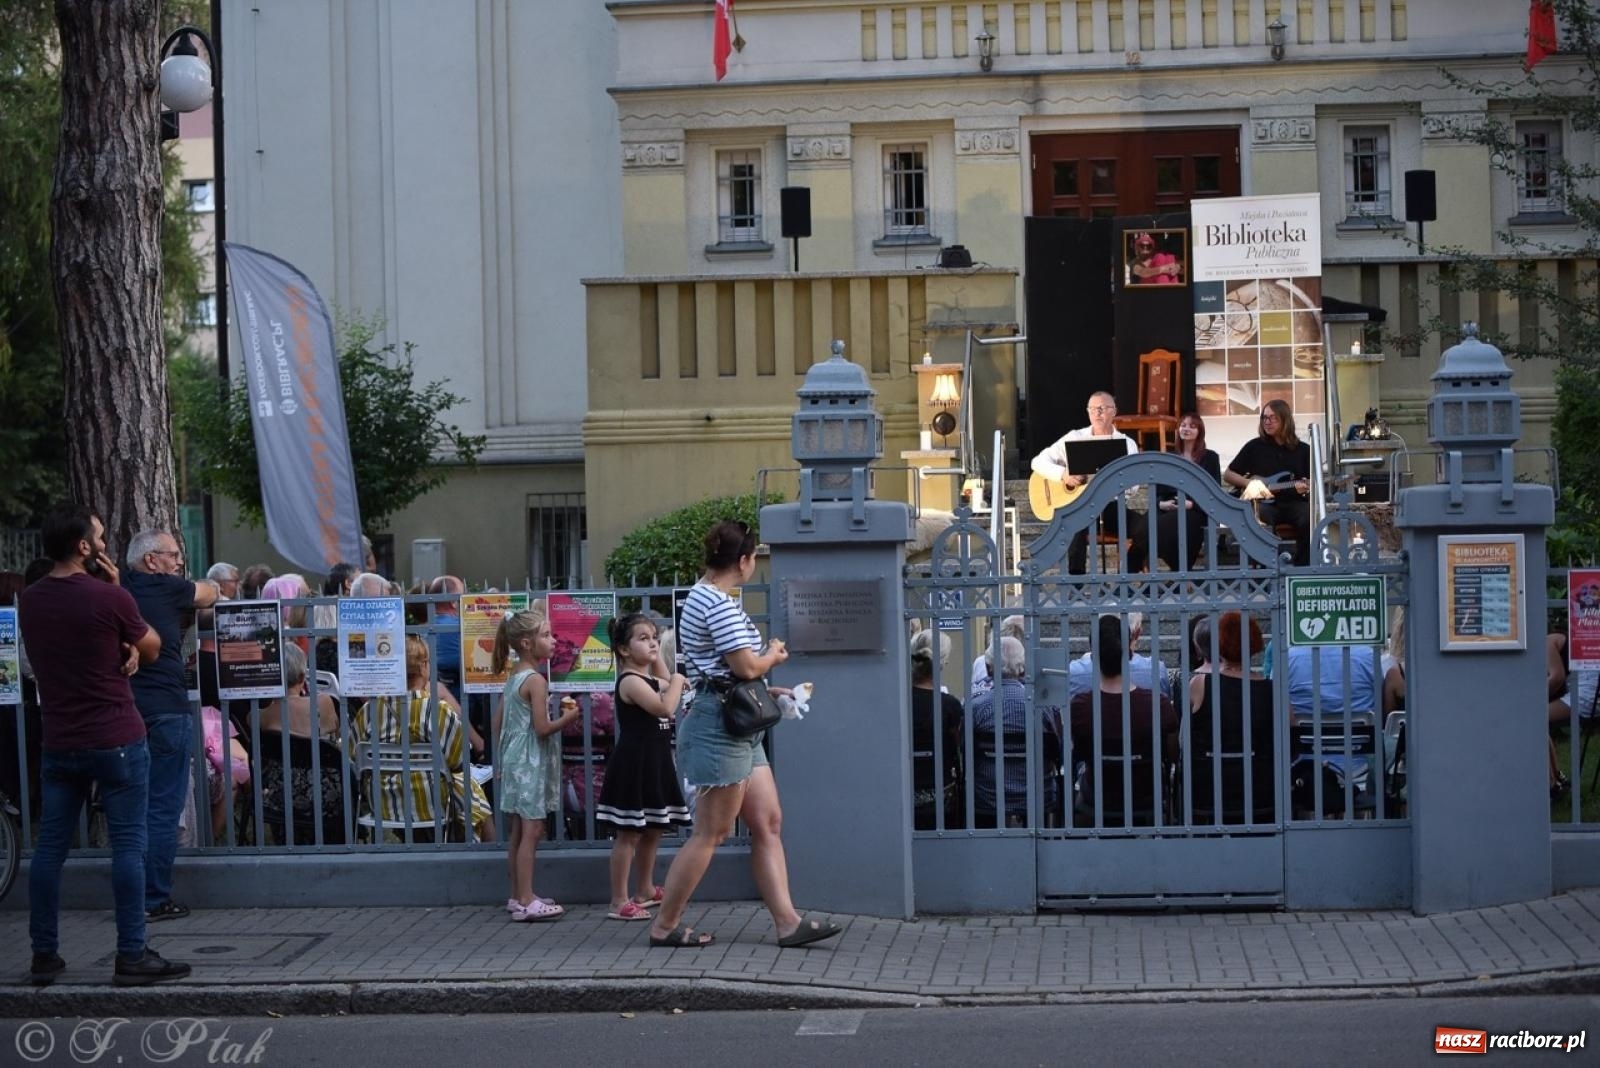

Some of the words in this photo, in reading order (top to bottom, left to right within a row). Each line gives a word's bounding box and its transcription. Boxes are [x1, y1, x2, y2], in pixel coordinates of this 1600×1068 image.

[1206, 220, 1307, 246] Biblioteka
[1245, 246, 1301, 260] Publiczna
[1455, 547, 1508, 557] BIBLIOTEKA
[1296, 587, 1320, 596] OBIEKT
[1322, 584, 1367, 596] WYPOSAŻONY
[1368, 586, 1376, 594] W
[1297, 598, 1376, 612] DEFIBRYLATOR
[1334, 616, 1377, 640] AED
